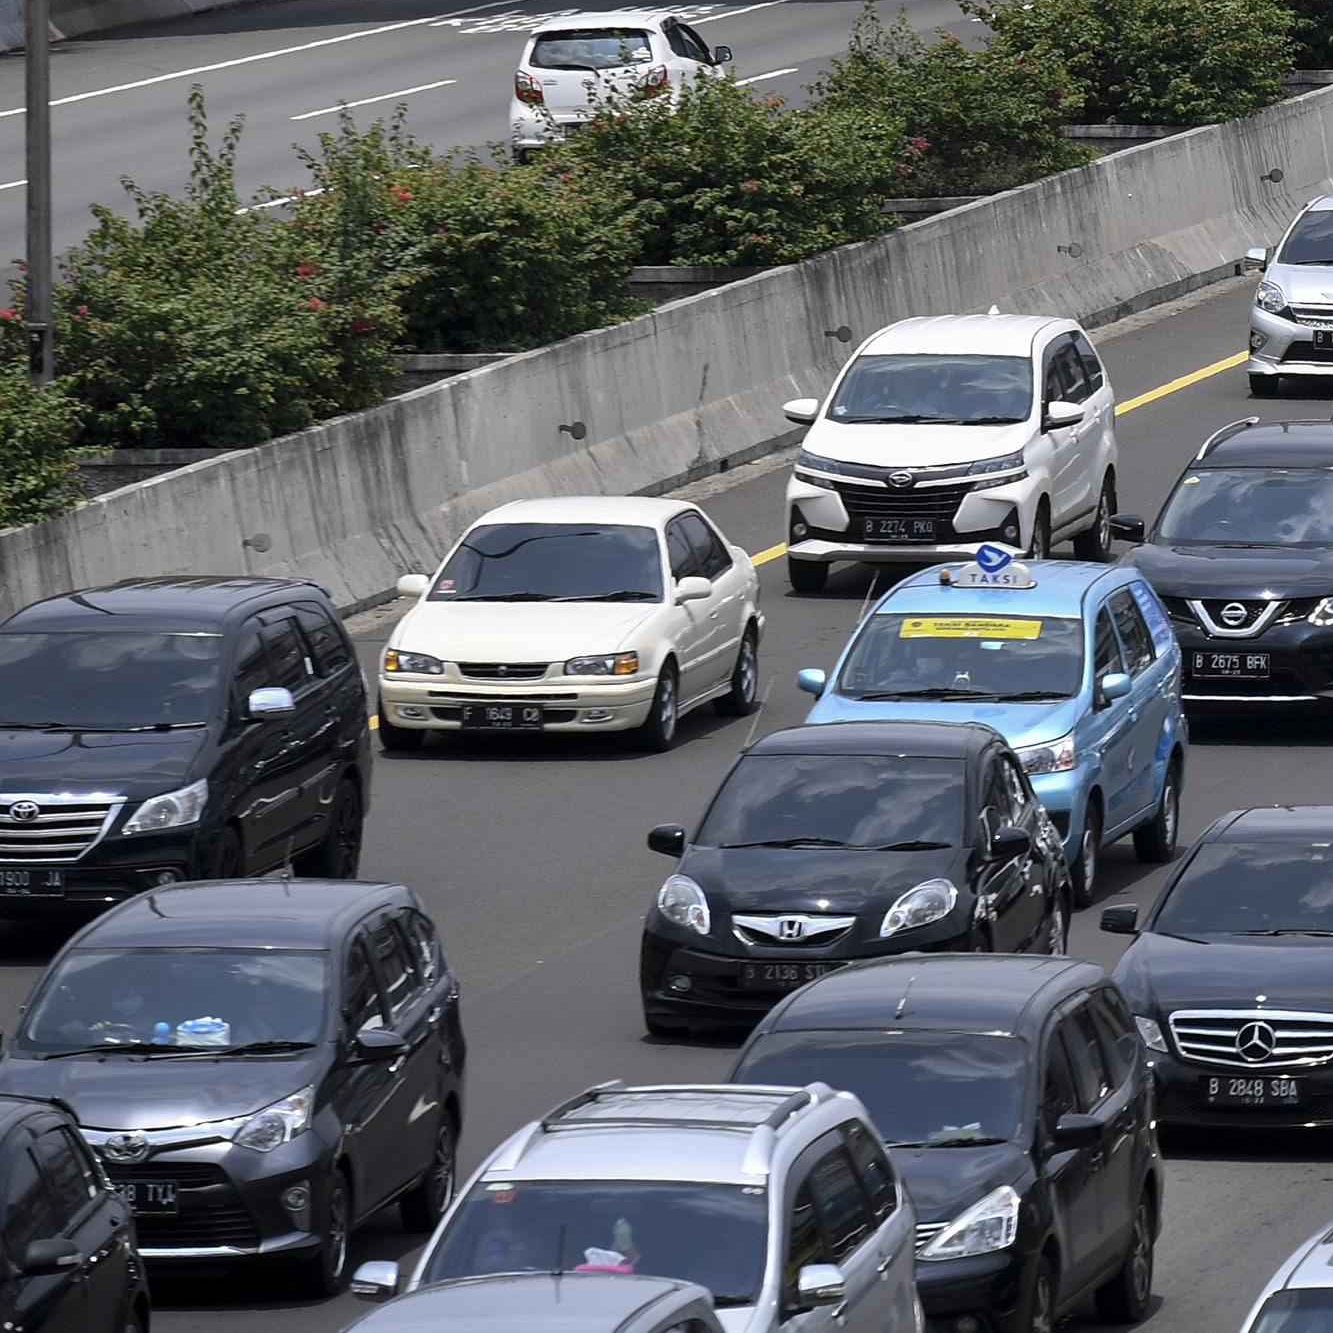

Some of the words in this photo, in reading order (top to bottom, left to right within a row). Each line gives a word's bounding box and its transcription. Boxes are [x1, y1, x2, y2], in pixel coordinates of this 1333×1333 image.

[1318, 333, 1323, 342] B
[866, 521, 873, 532] B
[880, 521, 906, 532] 2274
[970, 574, 1018, 584] TAKSI
[1196, 655, 1203, 668] B
[1211, 655, 1239, 668] 2675
[1247, 656, 1267, 669] BFK
[464, 708, 472, 719] F
[1210, 1078, 1218, 1095] B
[1229, 1079, 1264, 1096] 2848
[1271, 1080, 1297, 1096] SBA
